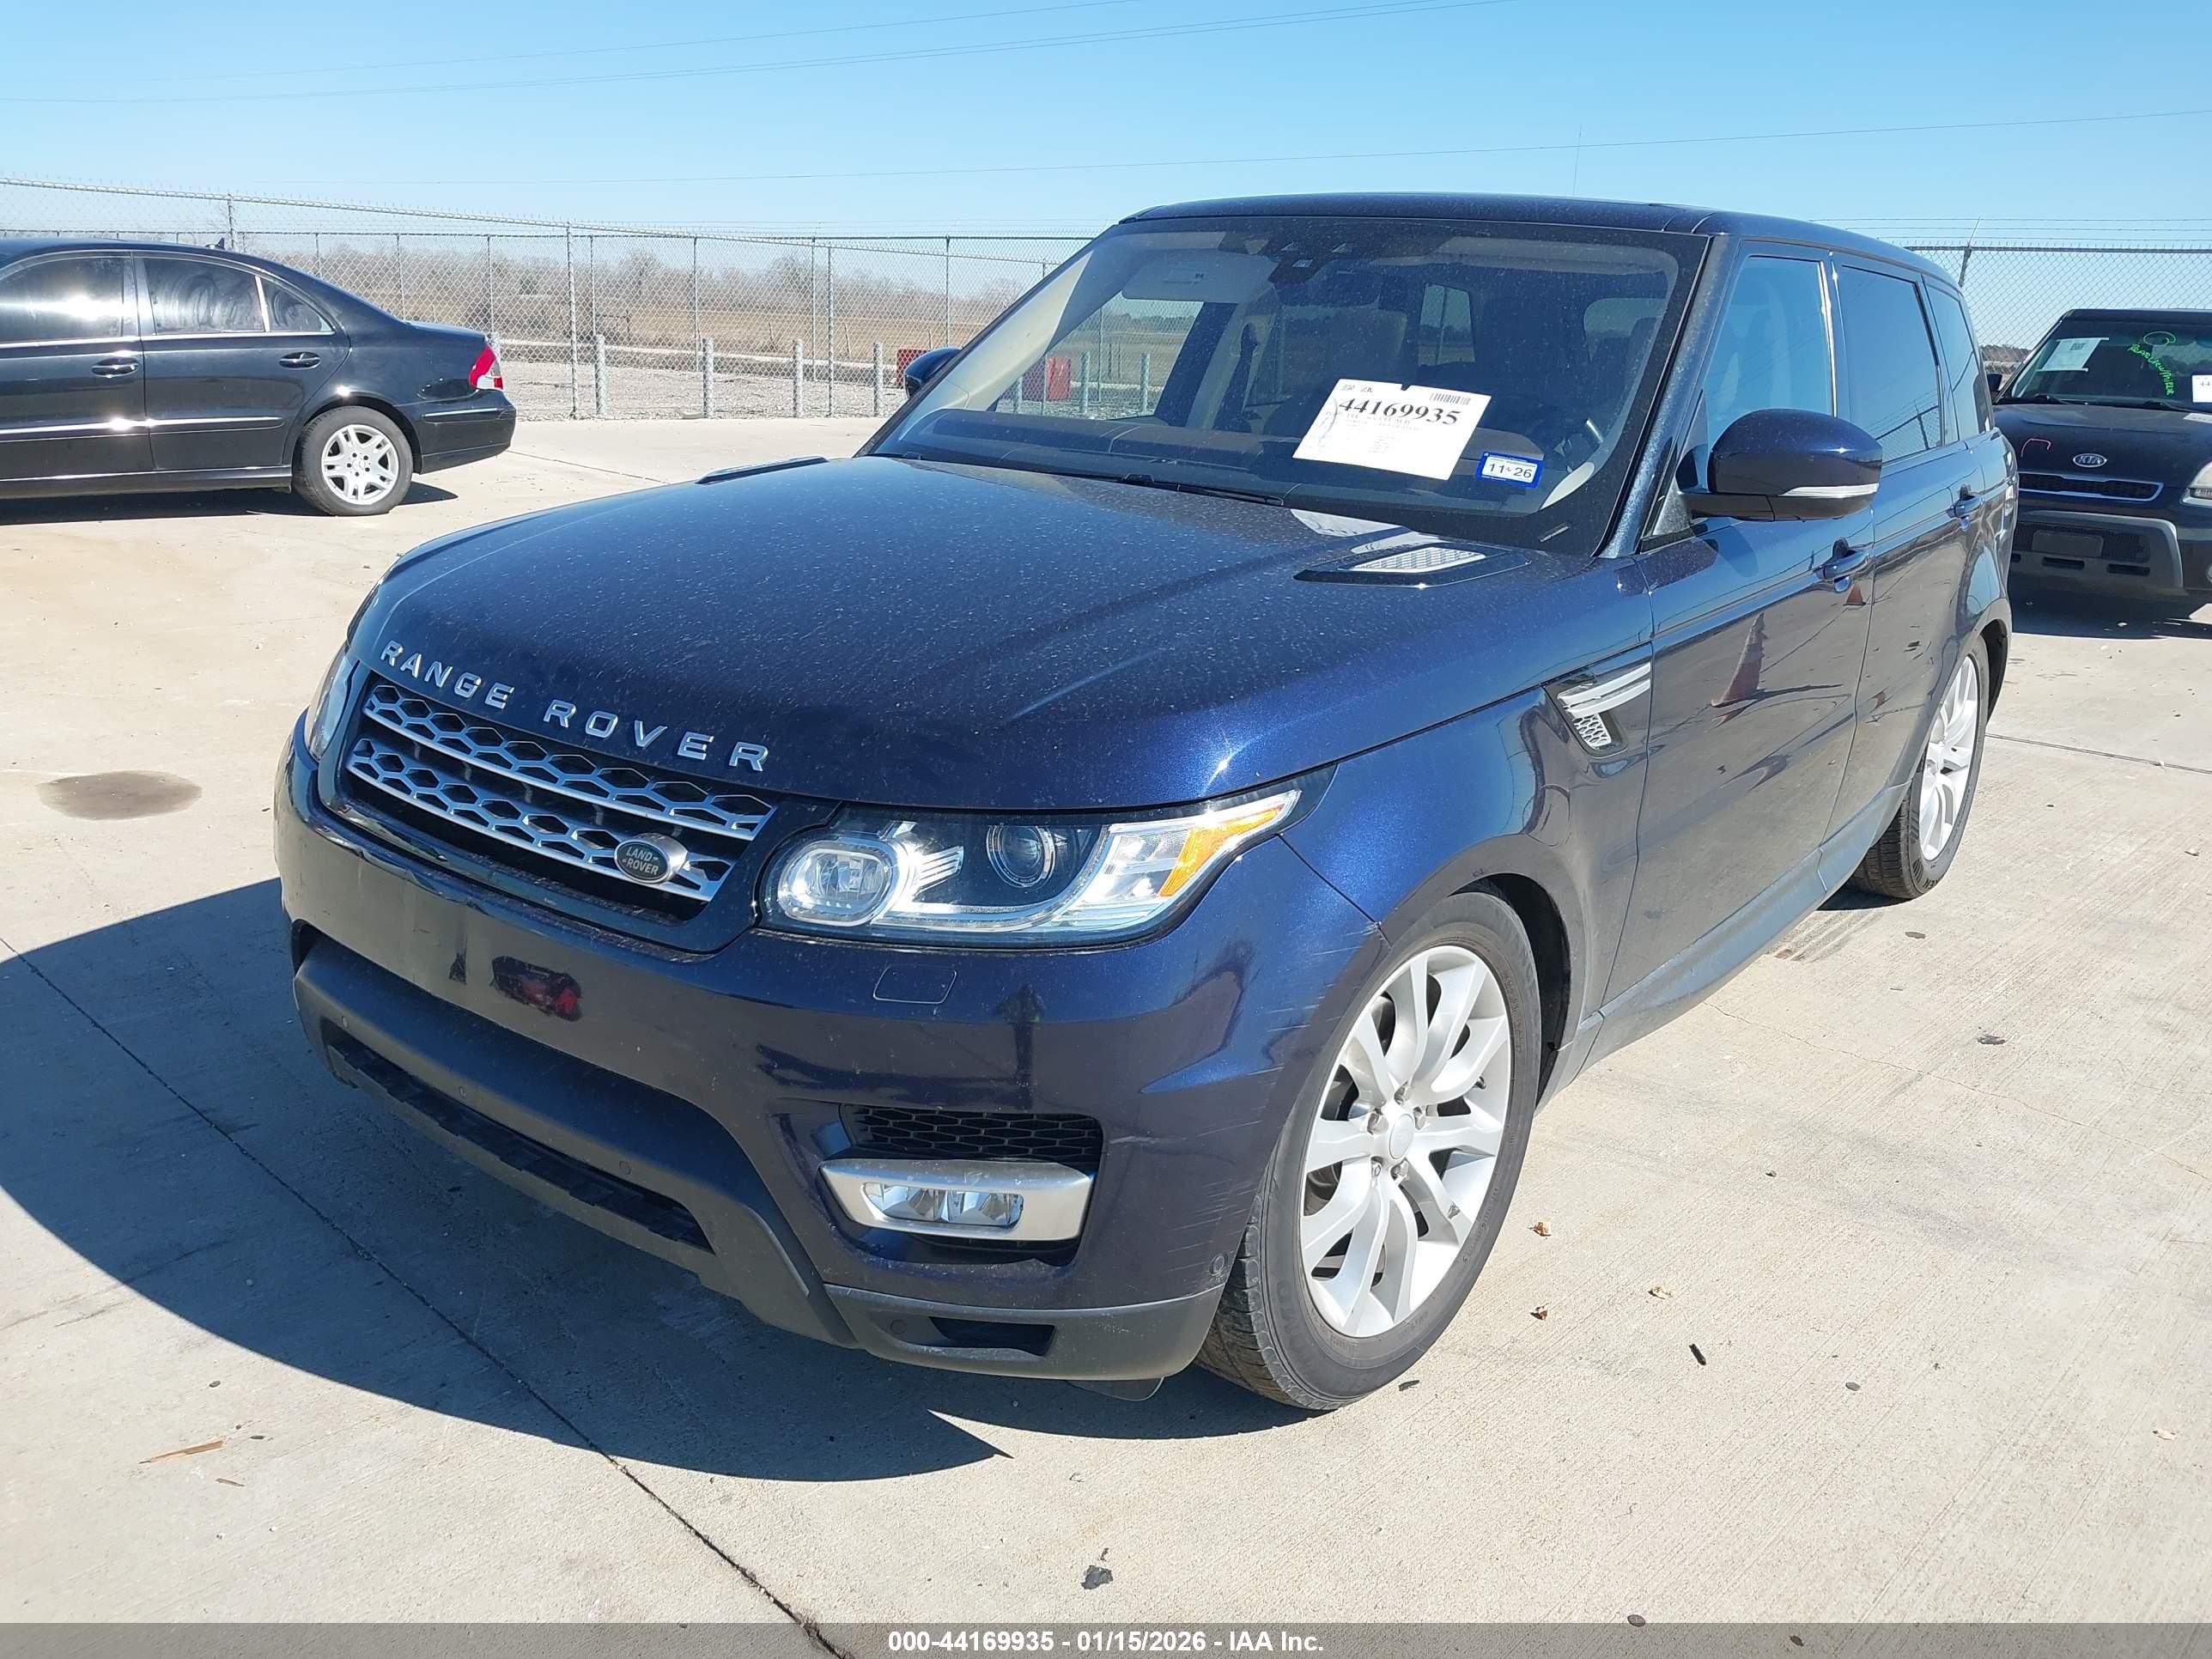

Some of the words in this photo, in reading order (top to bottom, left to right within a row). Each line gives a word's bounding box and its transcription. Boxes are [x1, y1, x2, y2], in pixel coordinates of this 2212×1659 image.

[1340, 398, 1462, 425] 44169935
[1489, 463, 1505, 474] 11
[1513, 467, 1533, 478] 26
[2077, 455, 2101, 465] KIA
[380, 640, 515, 710] RANGE
[543, 699, 769, 772] ROVER
